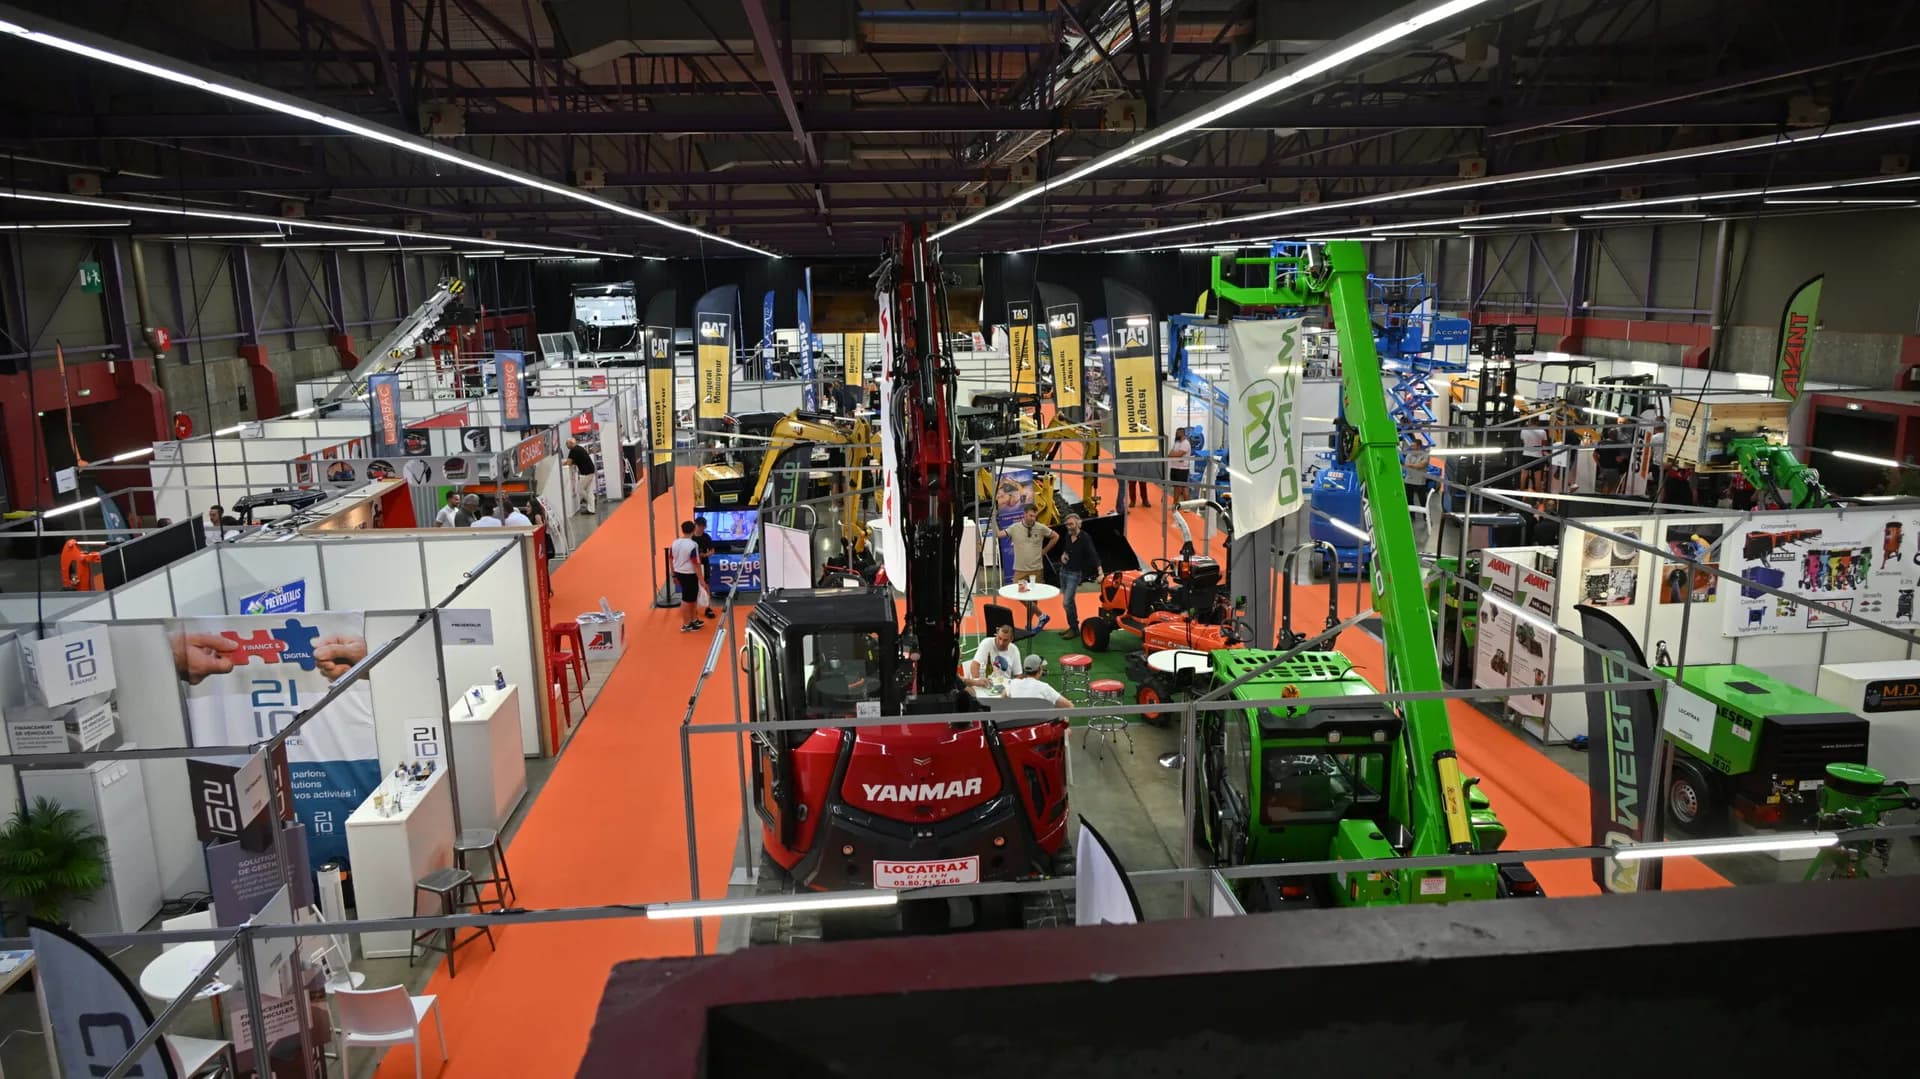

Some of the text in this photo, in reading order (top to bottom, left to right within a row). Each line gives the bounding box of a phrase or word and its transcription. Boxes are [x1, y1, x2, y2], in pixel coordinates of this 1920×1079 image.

[701, 321, 728, 338] CAT
[651, 337, 669, 359] CAT
[1781, 311, 1809, 400] AVANT
[655, 401, 664, 446] Bergerat
[1360, 481, 1385, 597] MERLO
[1487, 558, 1512, 577] AVANT
[1523, 572, 1551, 593] AVANT
[65, 639, 94, 662] 21
[242, 643, 273, 651] FINANCE
[283, 652, 311, 660] DIGITAL
[251, 679, 299, 708] 21
[413, 726, 437, 742] 21
[292, 769, 327, 779] parlons
[203, 780, 233, 807] 21
[313, 789, 350, 799] activités
[862, 777, 982, 802] YANMAR
[314, 811, 332, 822] 21
[883, 861, 969, 874] LOCATRAX
